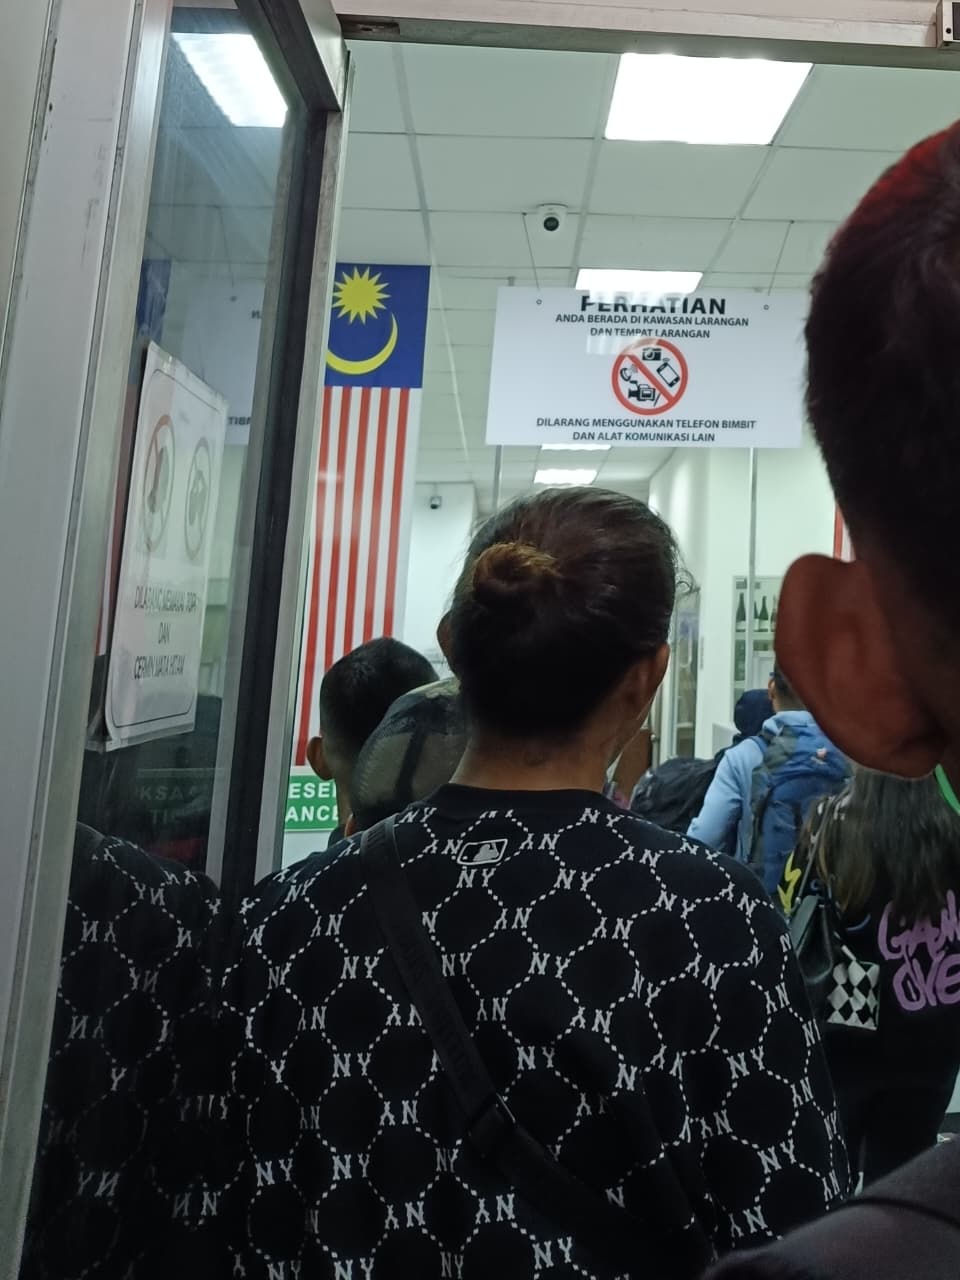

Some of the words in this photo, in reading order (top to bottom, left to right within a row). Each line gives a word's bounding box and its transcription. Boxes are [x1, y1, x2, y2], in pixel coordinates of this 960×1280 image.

[555, 313, 585, 323] ANDA
[587, 314, 628, 324] BERADA
[630, 315, 641, 324] DI
[643, 315, 692, 325] KAWASAN
[694, 317, 749, 327] LARANGAN
[590, 327, 612, 336] DAN
[614, 328, 653, 337] TEMPAT
[655, 329, 710, 339] LARANGAN
[536, 417, 590, 427] DILARANG
[592, 418, 674, 428] MENGGUNAKAN
[676, 419, 720, 429] TELEFON
[721, 420, 757, 430] BIMBIT
[572, 431, 595, 441] DAN
[597, 432, 623, 441] ALAT
[625, 432, 690, 442] KOMUNIKASI
[691, 433, 715, 442] LAIN
